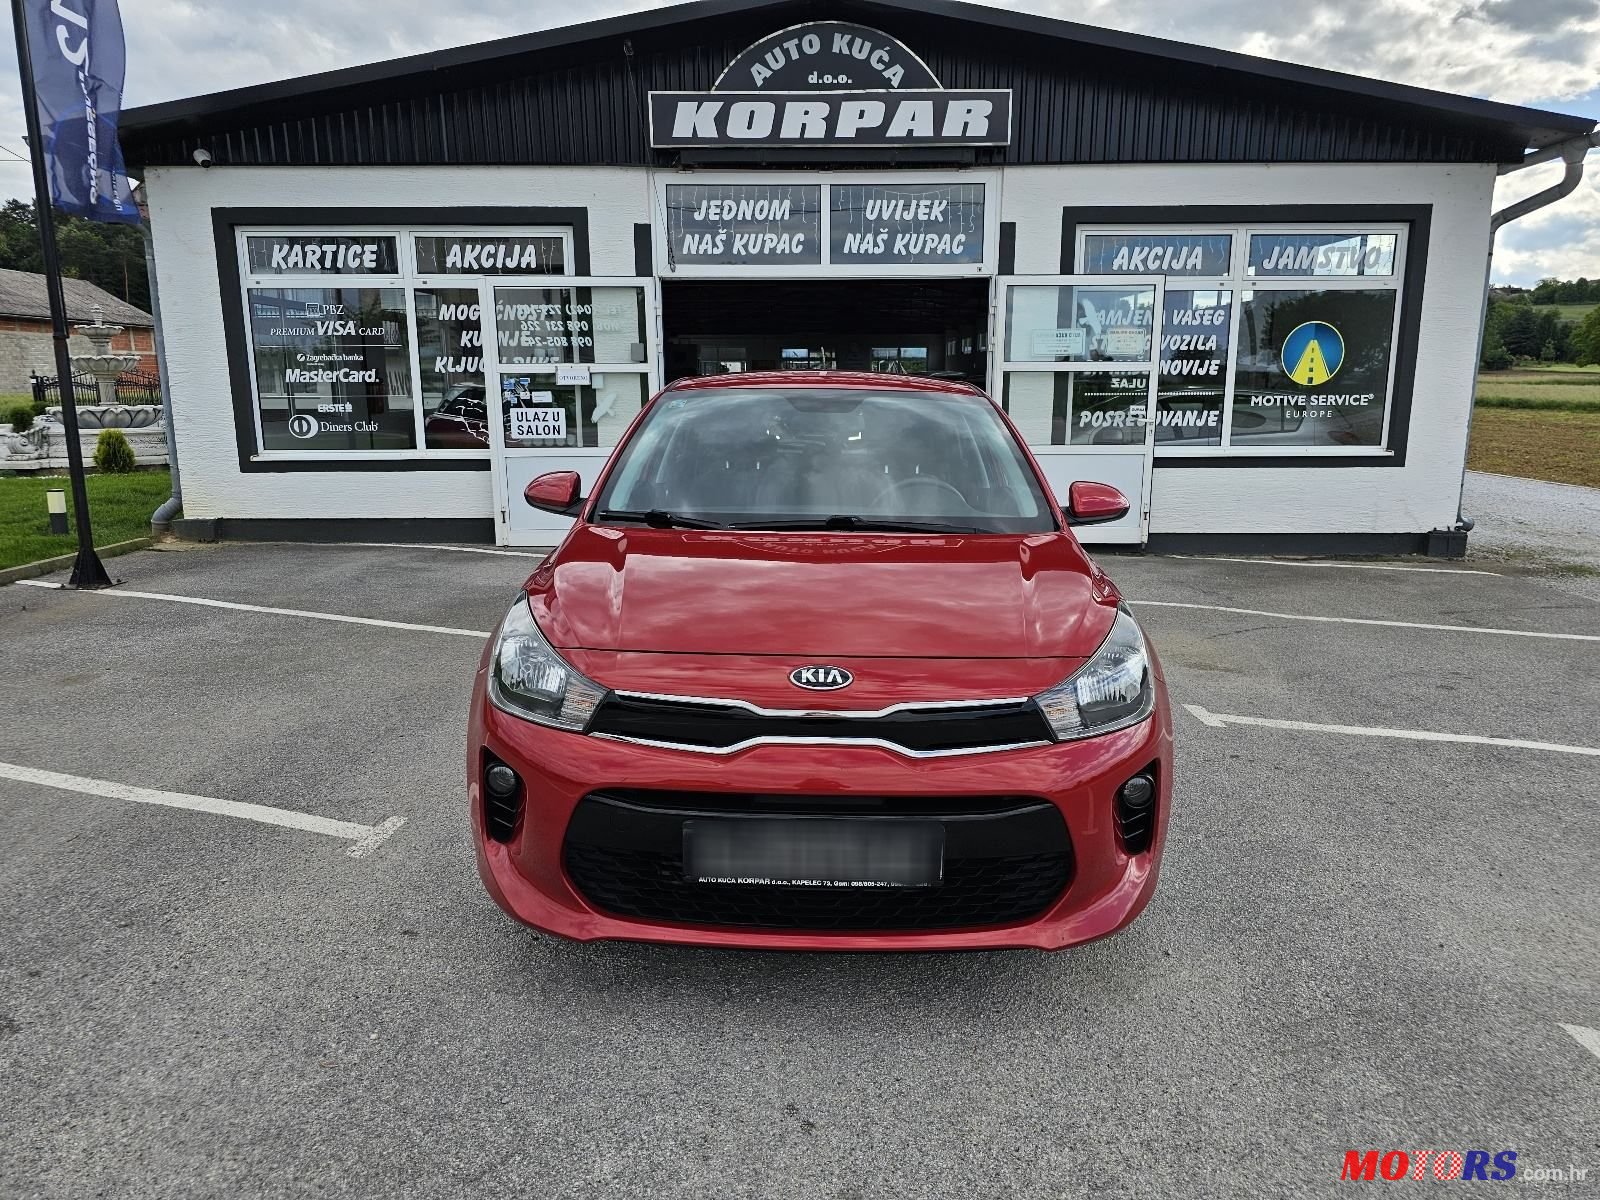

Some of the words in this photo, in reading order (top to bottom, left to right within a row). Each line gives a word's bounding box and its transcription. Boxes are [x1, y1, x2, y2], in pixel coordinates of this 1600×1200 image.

[750, 33, 821, 88] AUTO
[832, 32, 904, 88] KUĆA
[808, 72, 852, 84] d.o.o.
[672, 100, 993, 139] KORPAR
[694, 199, 790, 221] JEDNOM
[865, 199, 948, 222] UVIJEK
[682, 228, 727, 255] NAŠ
[732, 232, 804, 256] KUPAC
[843, 228, 889, 255] NAŠ
[893, 233, 966, 255] KUPAC
[271, 244, 378, 270] KARTICE
[446, 244, 537, 270] AKCIJA
[1112, 246, 1202, 272] AKCIJA
[1262, 246, 1383, 271] JAMSTVO
[323, 305, 344, 315] PBZ
[270, 328, 315, 336] PREMIUM
[315, 320, 356, 336] VISA
[359, 327, 384, 336] CARD
[460, 330, 530, 347] KUNJE
[1161, 334, 1217, 351] VOZILA
[1160, 359, 1220, 376] NOVIJE
[318, 403, 345, 413] ERSTE
[1250, 394, 1306, 407] MOTIVE
[516, 411, 548, 422] ULAZ
[552, 411, 560, 422] U
[1285, 410, 1333, 418] EUROPE
[320, 421, 353, 432] Diners
[517, 425, 561, 436] SALON
[801, 668, 842, 683] KIA
